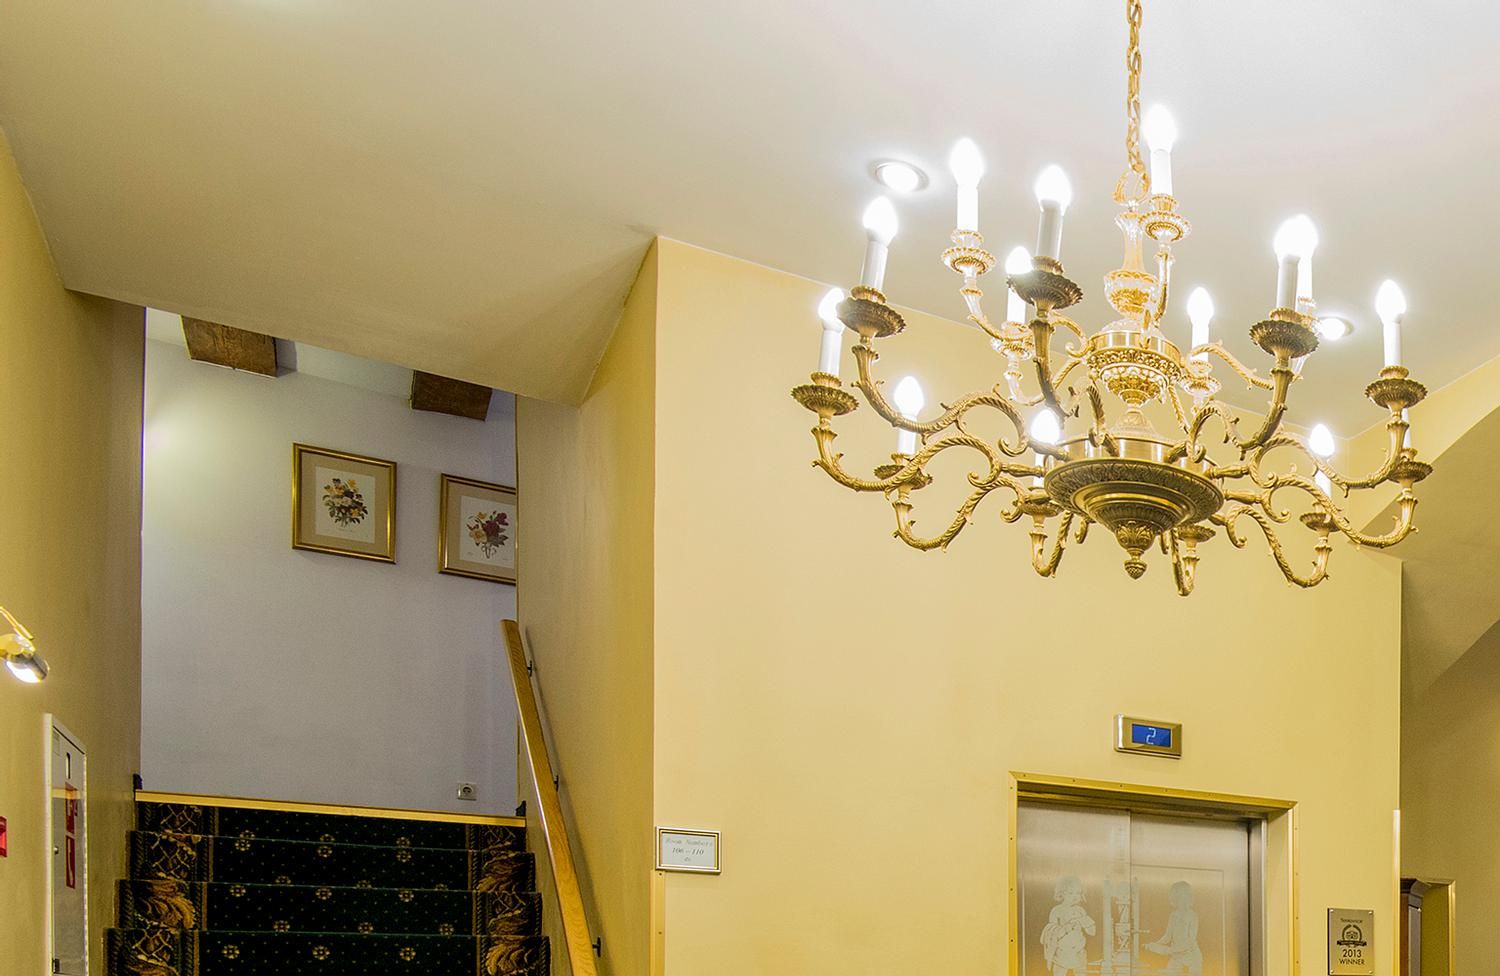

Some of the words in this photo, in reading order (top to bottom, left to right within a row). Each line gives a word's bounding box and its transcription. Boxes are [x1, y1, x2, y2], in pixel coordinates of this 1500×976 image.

[1145, 727, 1156, 745] 2
[1342, 949, 1362, 958] 2013
[1339, 958, 1365, 966] WINNER
